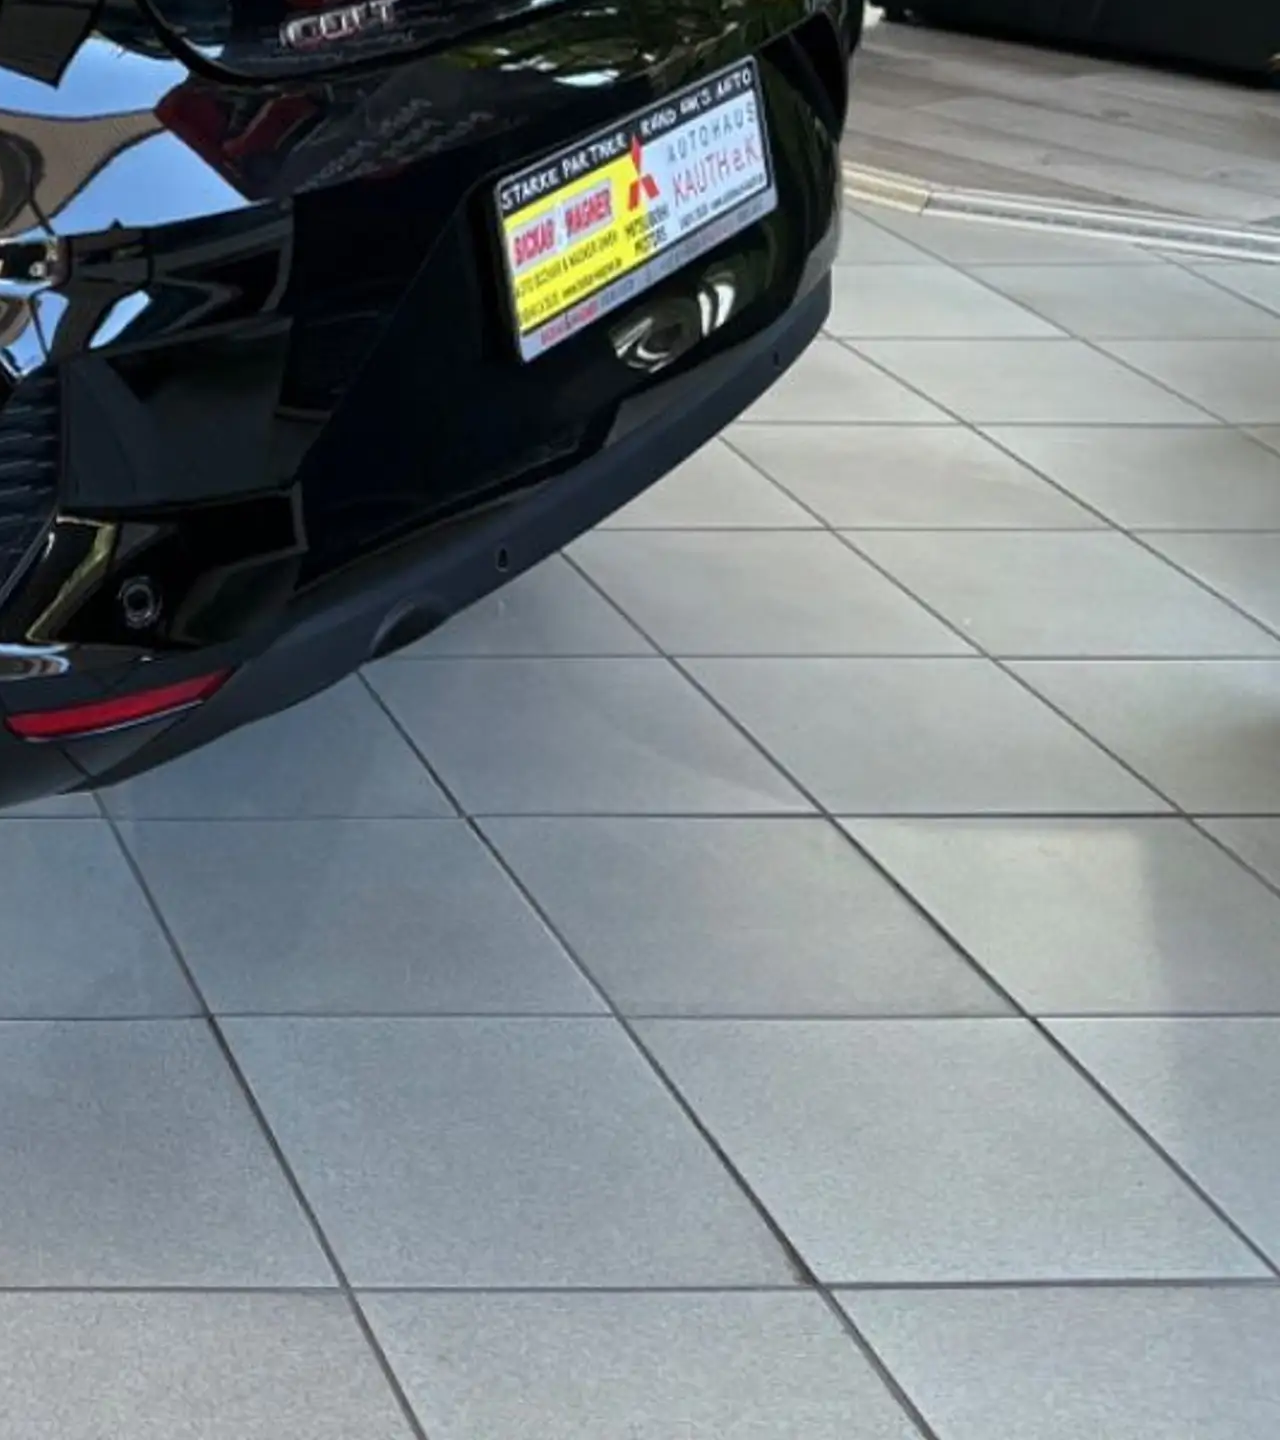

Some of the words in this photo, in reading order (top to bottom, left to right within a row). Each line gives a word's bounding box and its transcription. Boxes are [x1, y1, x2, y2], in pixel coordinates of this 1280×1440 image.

[666, 100, 756, 165] AUTOHAUS
[500, 165, 559, 211] STARKE
[561, 131, 627, 176] PARTNER
